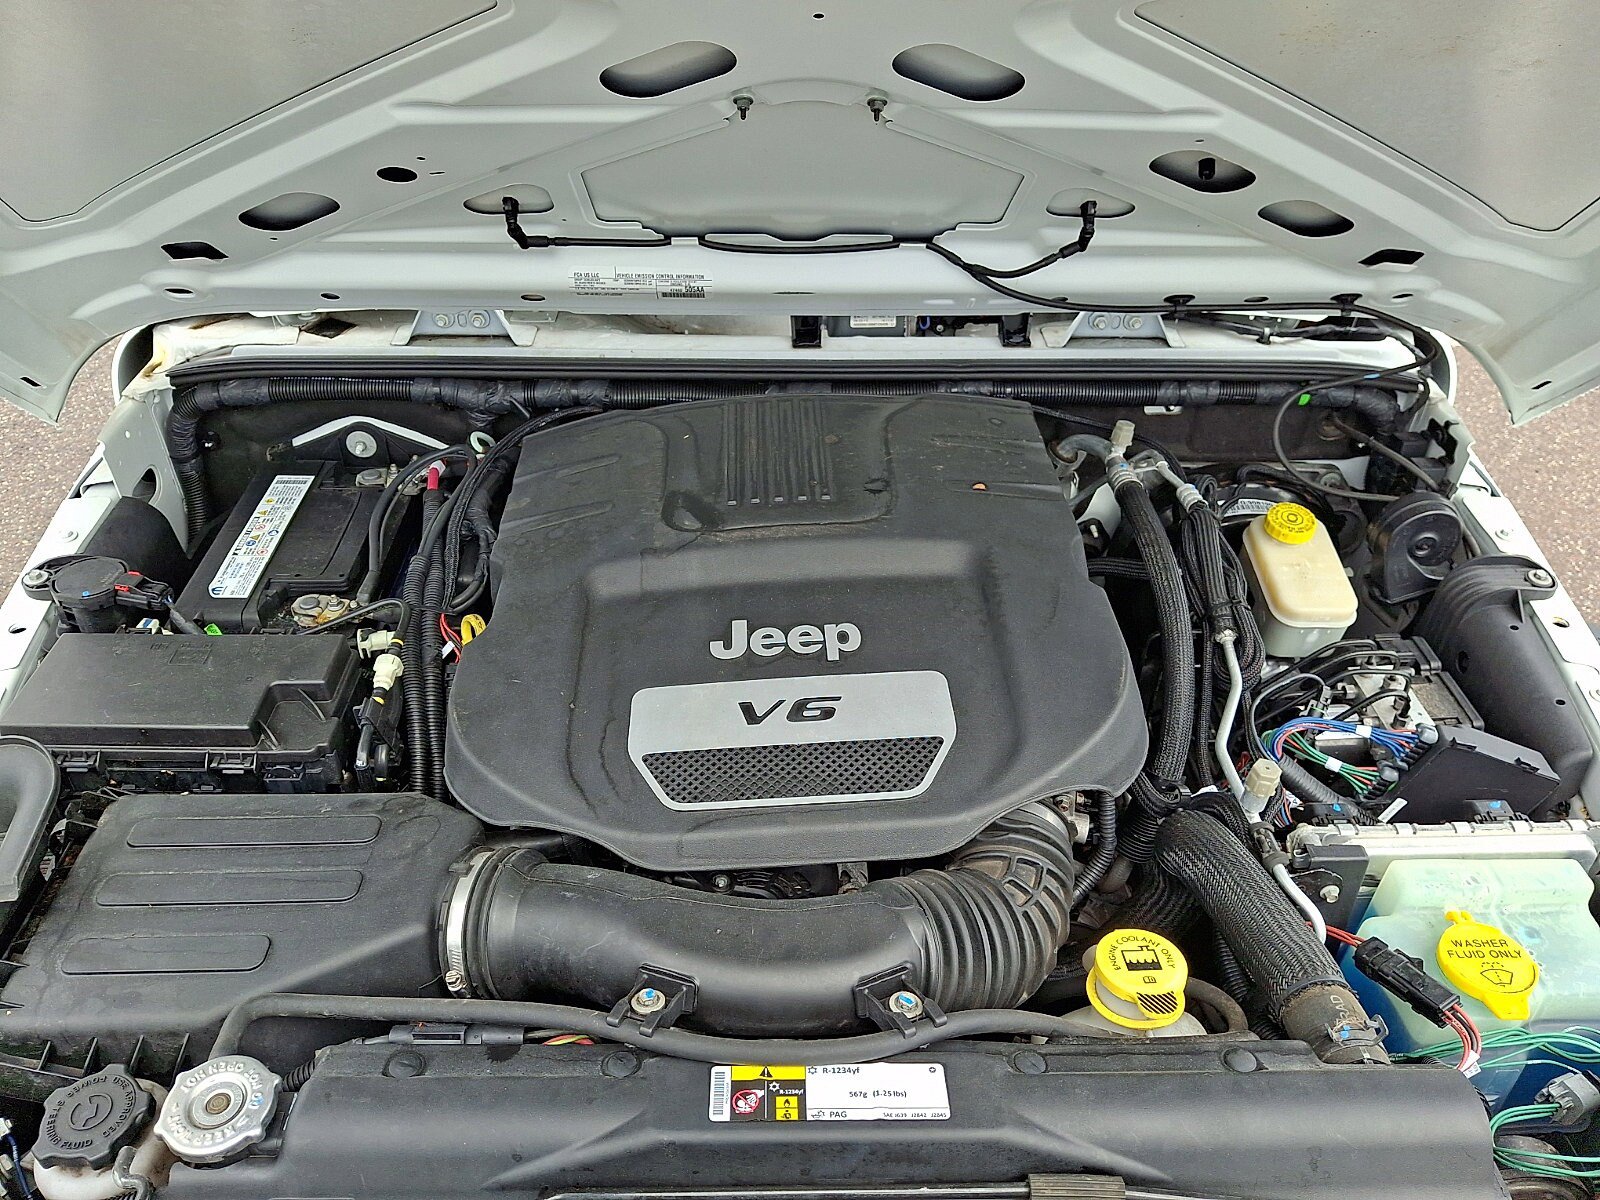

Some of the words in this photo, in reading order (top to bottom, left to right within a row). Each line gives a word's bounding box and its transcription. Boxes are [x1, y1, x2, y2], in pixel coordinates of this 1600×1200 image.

[709, 619, 862, 661] Jeep
[737, 696, 843, 726] V6
[1450, 939, 1509, 948] WASHER
[1108, 944, 1121, 971] ENGINE
[1116, 935, 1161, 947] COOLANT
[1160, 948, 1176, 969] ONLY
[1447, 949, 1486, 959] FLUID
[1489, 949, 1522, 959] ONLY
[208, 1060, 244, 1074] OPEN
[822, 1066, 861, 1075] R-1234yf
[112, 1076, 130, 1090] USE
[102, 1091, 135, 1138] APPROVED
[829, 1110, 848, 1119] PAG
[60, 1139, 93, 1150] FLUID
